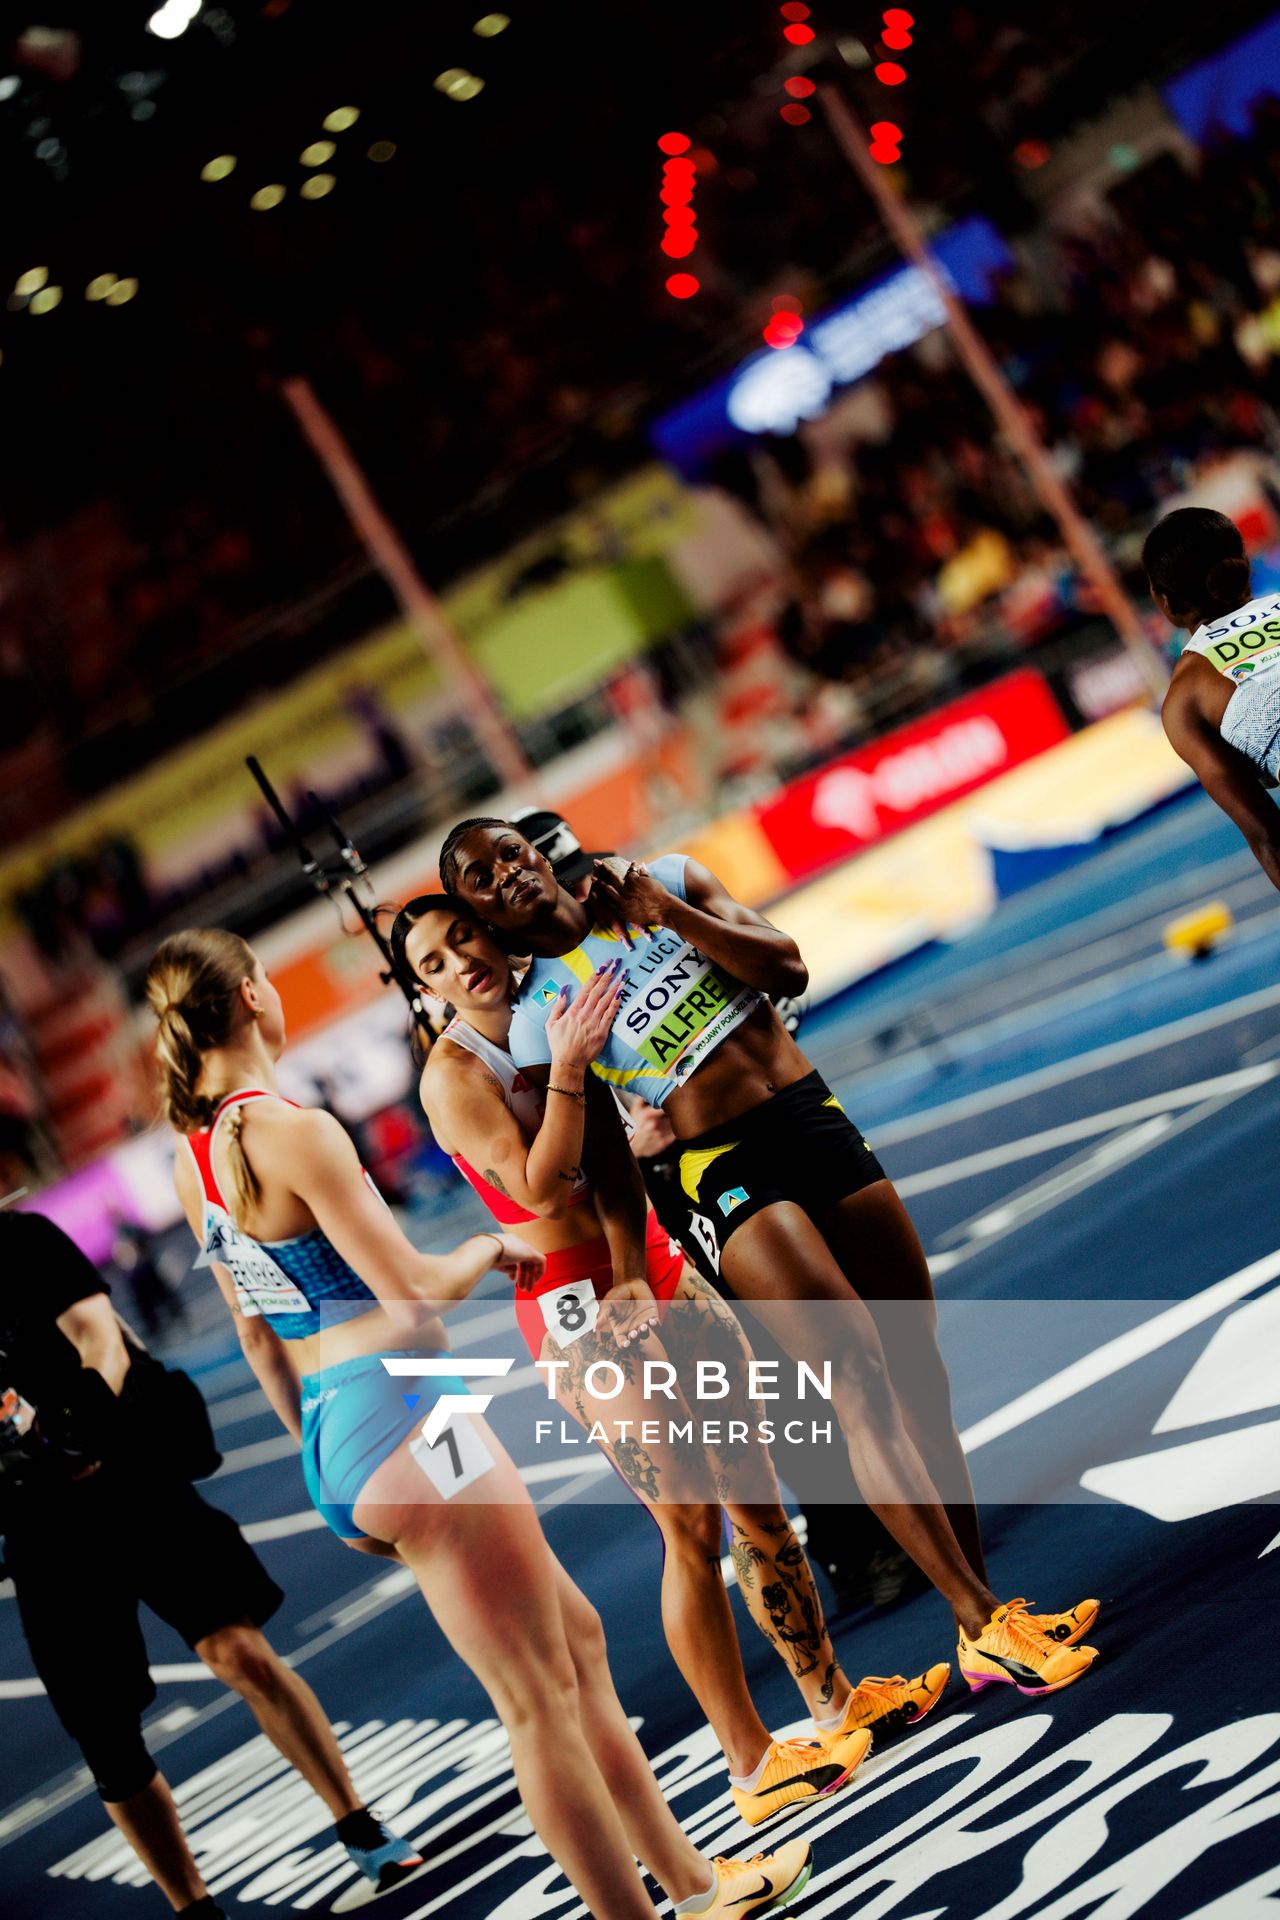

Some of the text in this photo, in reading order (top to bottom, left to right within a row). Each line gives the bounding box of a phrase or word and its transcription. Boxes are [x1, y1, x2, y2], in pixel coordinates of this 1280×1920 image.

[639, 935, 686, 973] LUCI
[626, 947, 706, 1035] SONY
[695, 1022, 723, 1053] KUJAWY
[698, 1217, 715, 1259] 5
[556, 1294, 587, 1332] 8
[427, 1426, 464, 1479] 7
